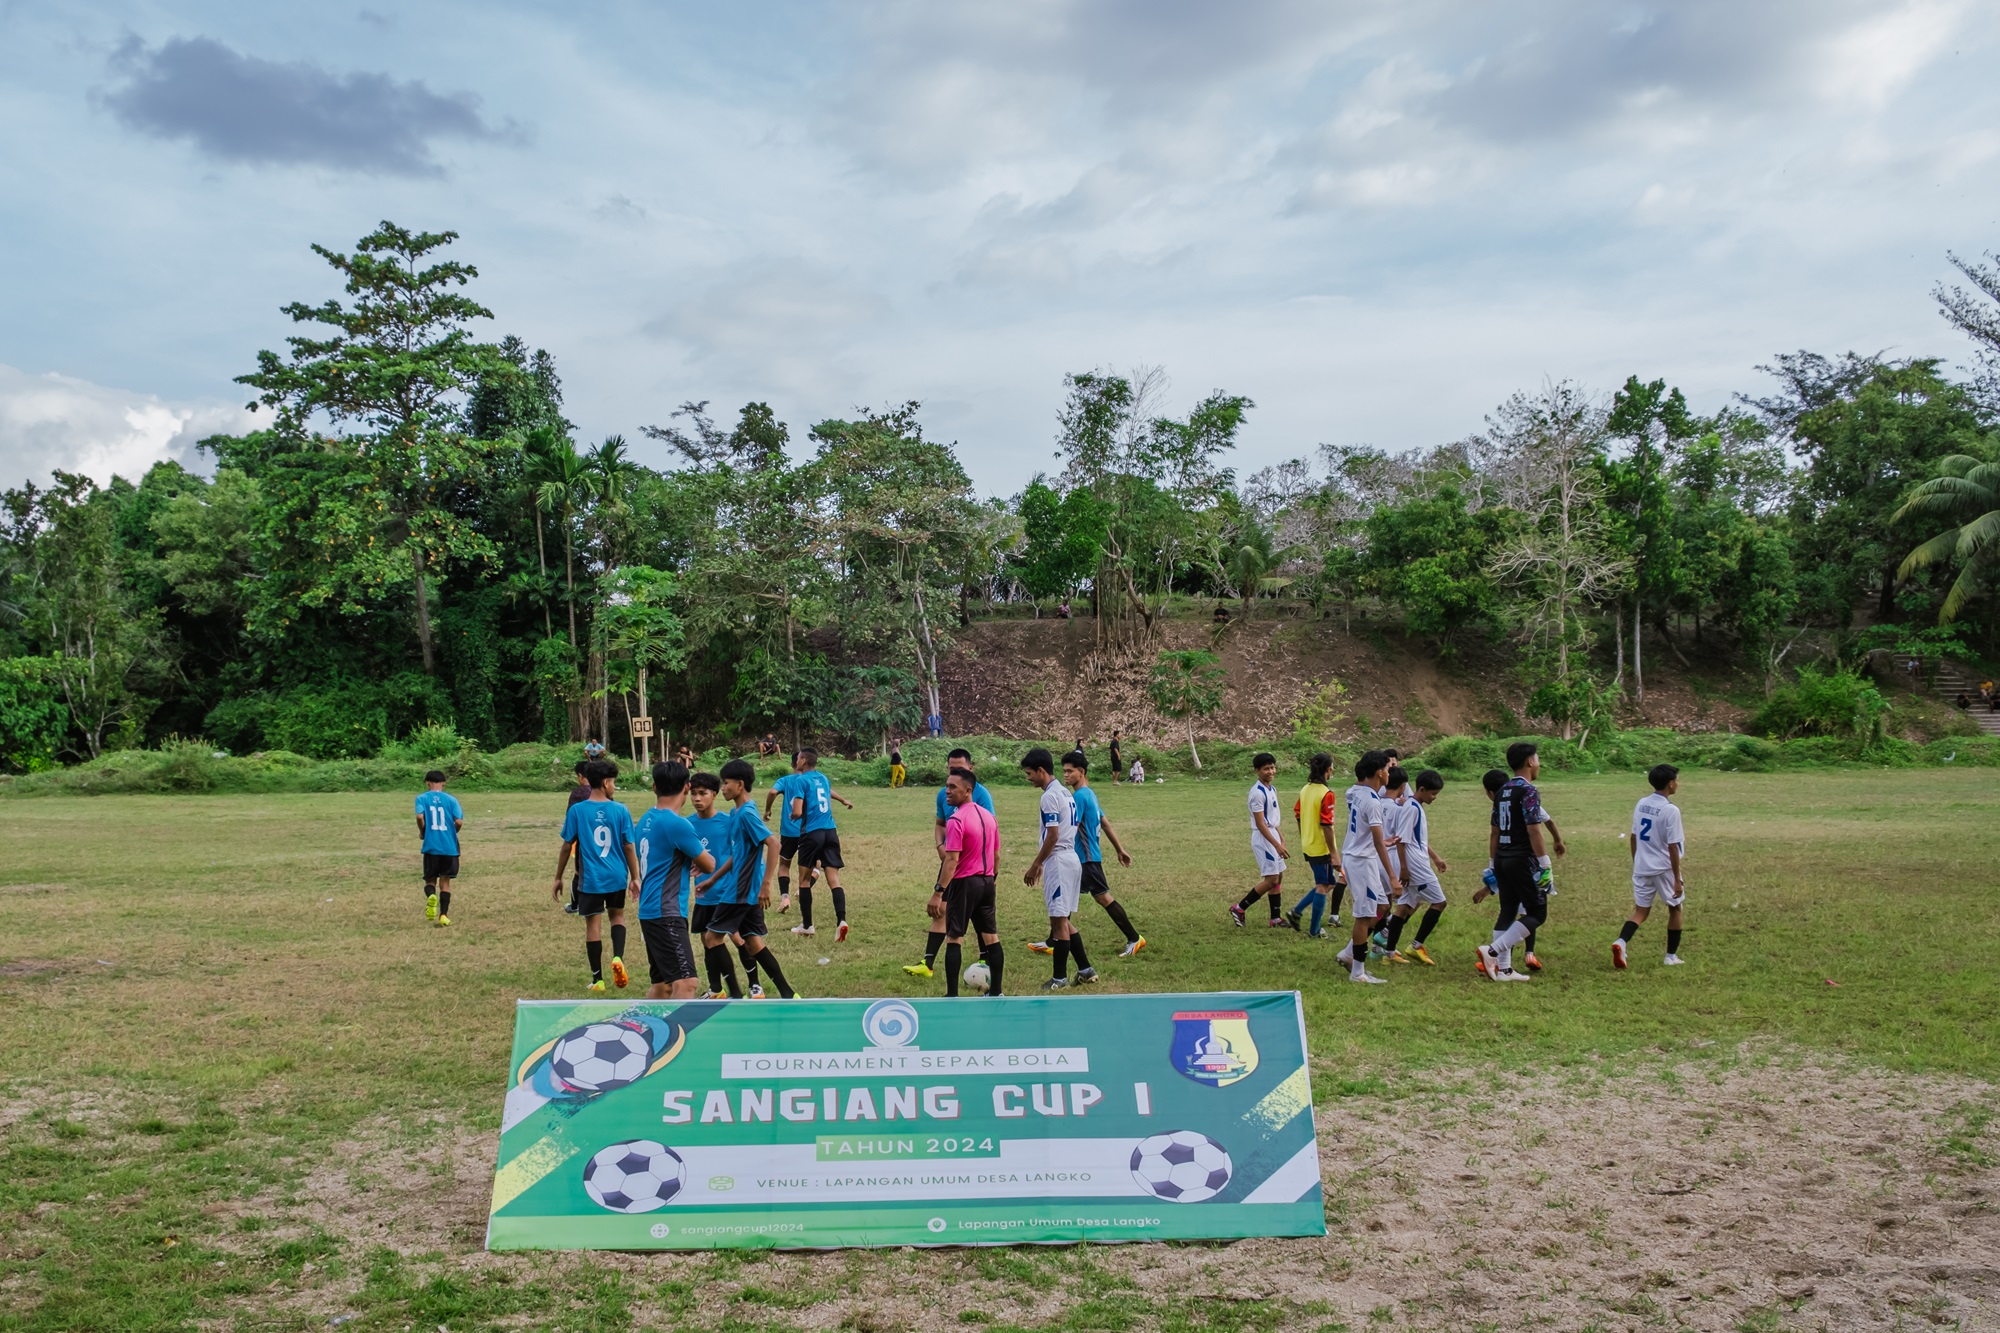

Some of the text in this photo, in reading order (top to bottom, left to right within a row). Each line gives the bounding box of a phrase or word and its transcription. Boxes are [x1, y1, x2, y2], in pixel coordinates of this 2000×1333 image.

[817, 788, 829, 814] 5
[429, 806, 448, 831] 11
[1351, 808, 1357, 833] 5
[1640, 818, 1652, 841] 2
[593, 825, 612, 858] 9
[639, 837, 649, 880] 8
[741, 1053, 1070, 1071] TOURNAMENT SEPAK BOLA
[663, 1081, 1152, 1123] SANGIANG CUP I
[821, 1137, 995, 1155] TAHUN 2024
[757, 1177, 809, 1188] VENUE
[826, 1176, 914, 1187] LAPANGAN
[920, 1175, 971, 1185] UMUM
[977, 1174, 1019, 1184] DESA
[1025, 1172, 1092, 1182] LANGKO
[958, 1216, 1161, 1231] Lapangan Umum Desa Langko
